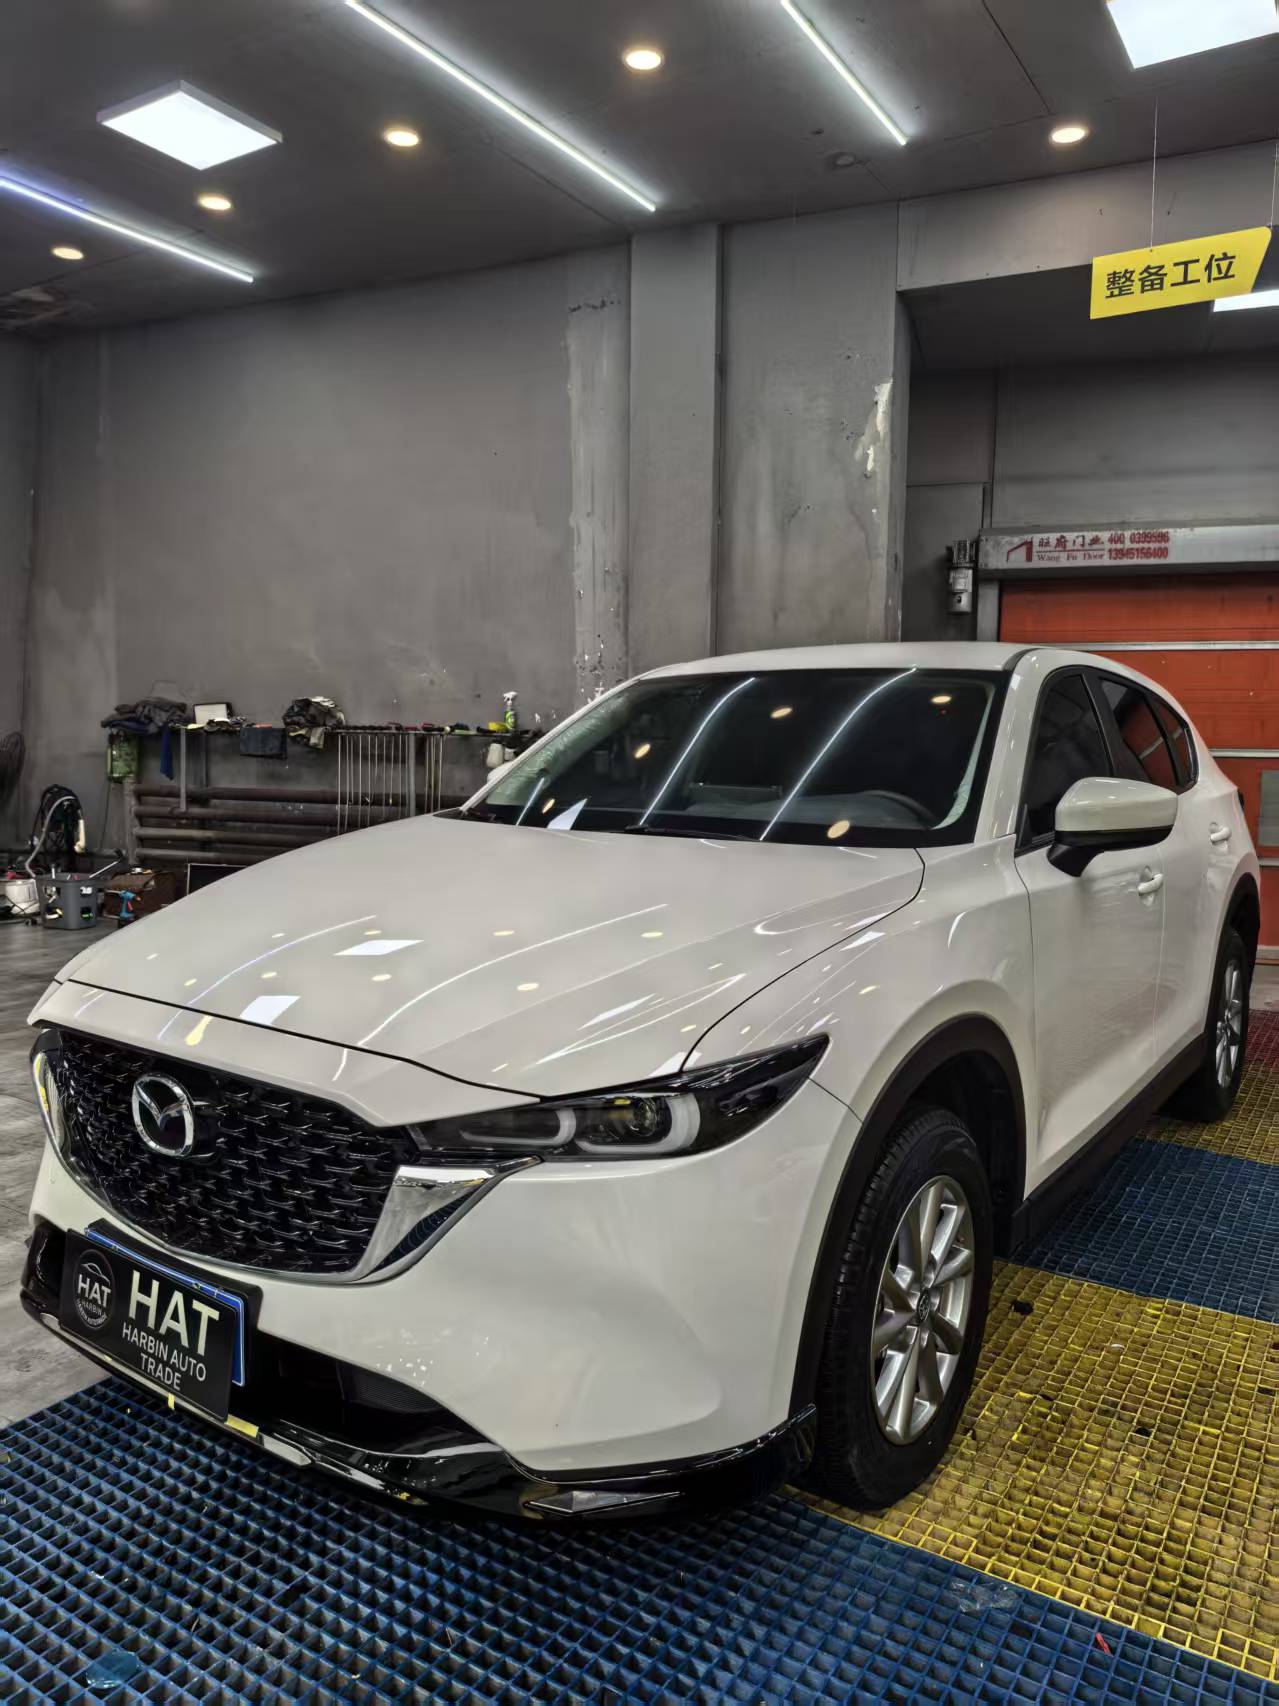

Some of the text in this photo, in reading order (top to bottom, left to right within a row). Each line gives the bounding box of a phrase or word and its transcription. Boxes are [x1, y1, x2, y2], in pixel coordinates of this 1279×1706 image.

[1105, 252, 1236, 299] 整备工位
[1108, 531, 1125, 545] 400
[77, 1273, 112, 1308] HAT
[128, 1269, 220, 1356] HAT
[122, 1322, 207, 1383] HARBIN AUTO
[140, 1352, 182, 1391] TRADE
